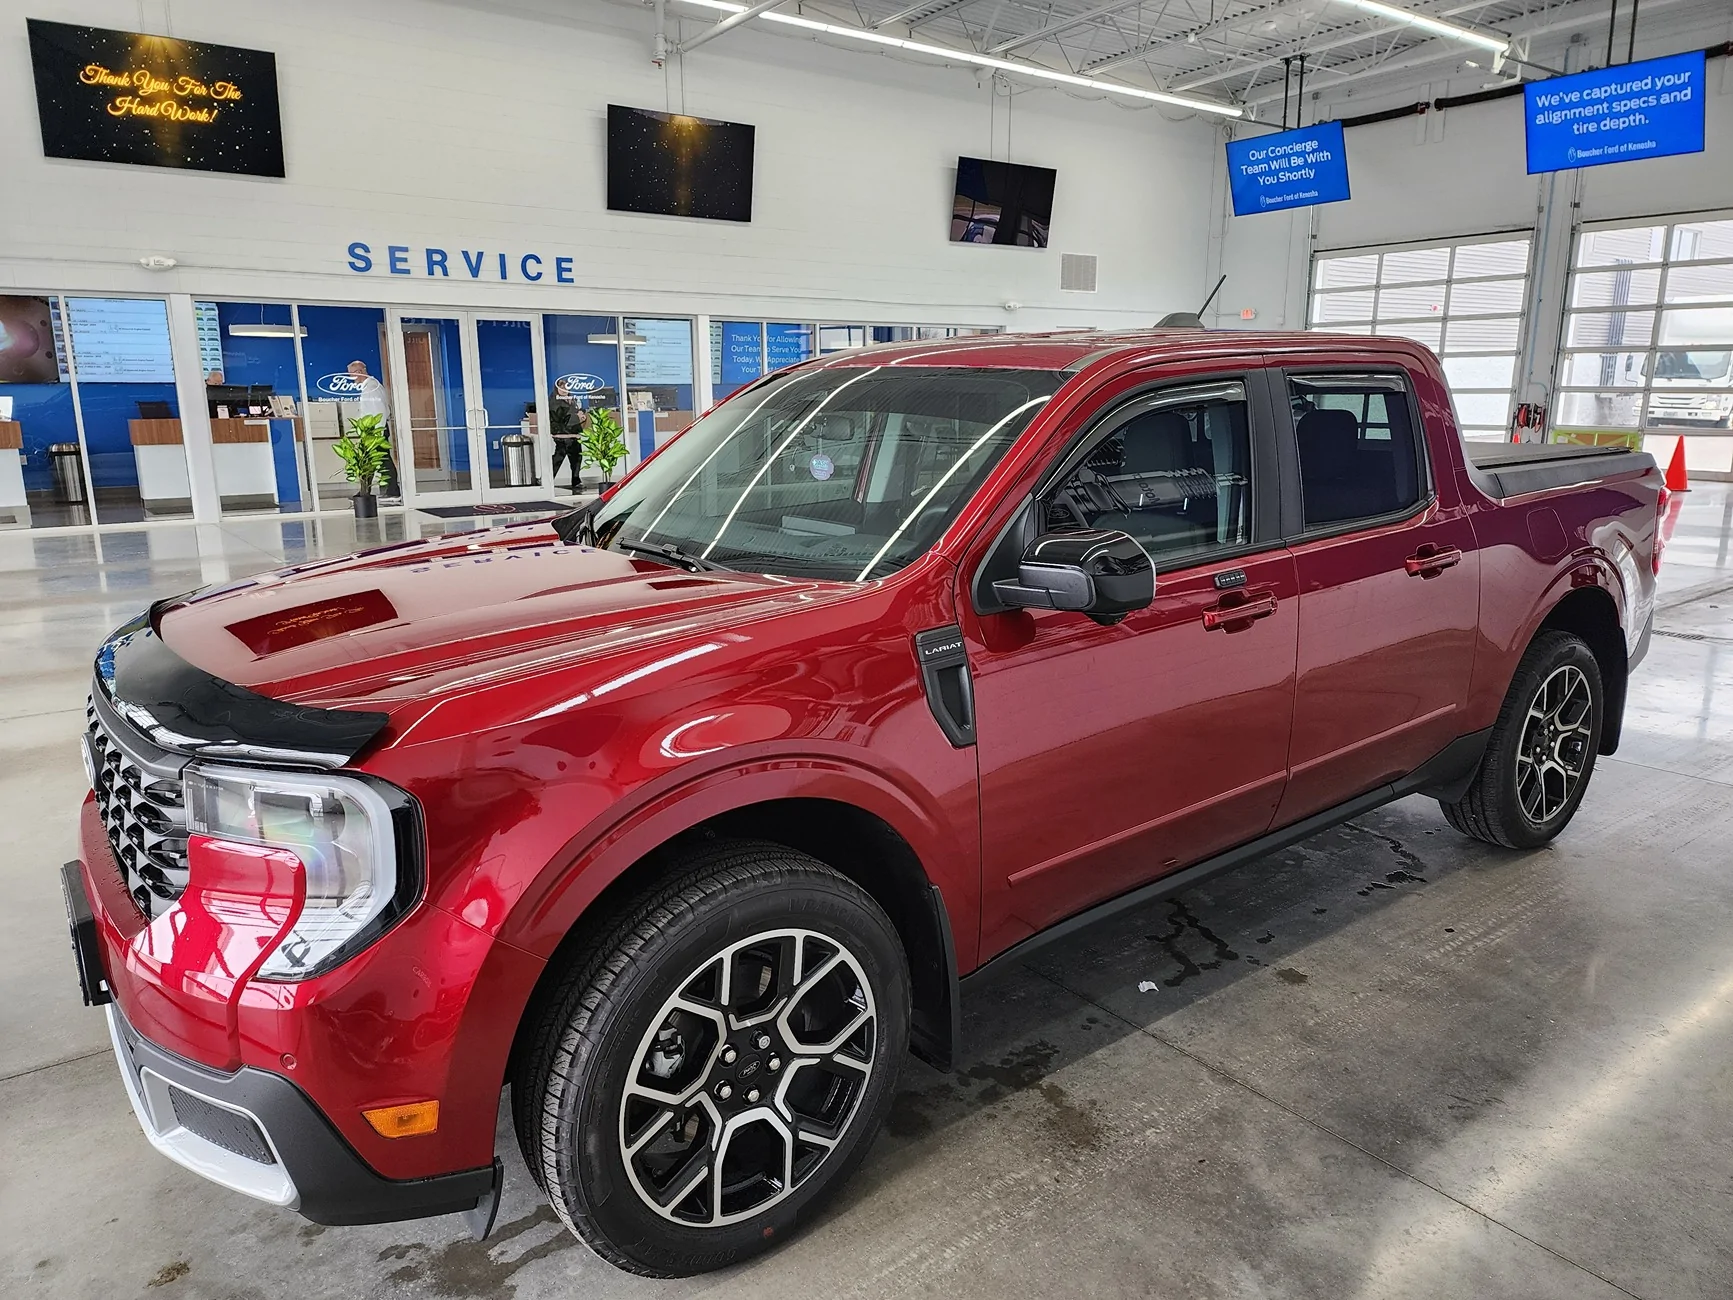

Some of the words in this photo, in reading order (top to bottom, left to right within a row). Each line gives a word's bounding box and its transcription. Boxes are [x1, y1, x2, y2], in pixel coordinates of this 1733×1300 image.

[79, 64, 132, 87] Thank
[133, 70, 170, 96] You
[173, 76, 208, 97] For
[210, 81, 242, 100] The
[1536, 91, 1580, 108] We've
[1582, 75, 1652, 100] captured
[1654, 71, 1691, 90] your
[107, 96, 160, 117] Hard
[160, 101, 218, 123] Work!
[1535, 101, 1609, 125] alignment
[1612, 94, 1657, 113] specs
[1660, 87, 1692, 105] and
[1572, 120, 1598, 135] tire
[1600, 113, 1650, 131] depth.
[1249, 149, 1267, 161] Our
[1268, 140, 1319, 157] Concierge
[1577, 148, 1603, 158] Boucher
[1604, 144, 1619, 154] Ford
[1620, 143, 1628, 152] of
[1628, 140, 1656, 151] Kenosha
[1241, 163, 1269, 175] Team
[1269, 158, 1290, 171] Will
[1290, 156, 1305, 167] Be
[1305, 150, 1332, 164] With
[1258, 174, 1277, 186] You
[1278, 167, 1315, 182] Shortly
[347, 242, 575, 284] SERVICE
[731, 334, 752, 342] Thank
[776, 336, 803, 344] Allowing
[731, 345, 743, 353] Our
[771, 345, 789, 353] Serve
[732, 355, 755, 364] Today.
[767, 356, 800, 364] Appreciate
[330, 375, 368, 391] Ford
[565, 375, 595, 390] Ford
[925, 641, 962, 655] LARIAT
